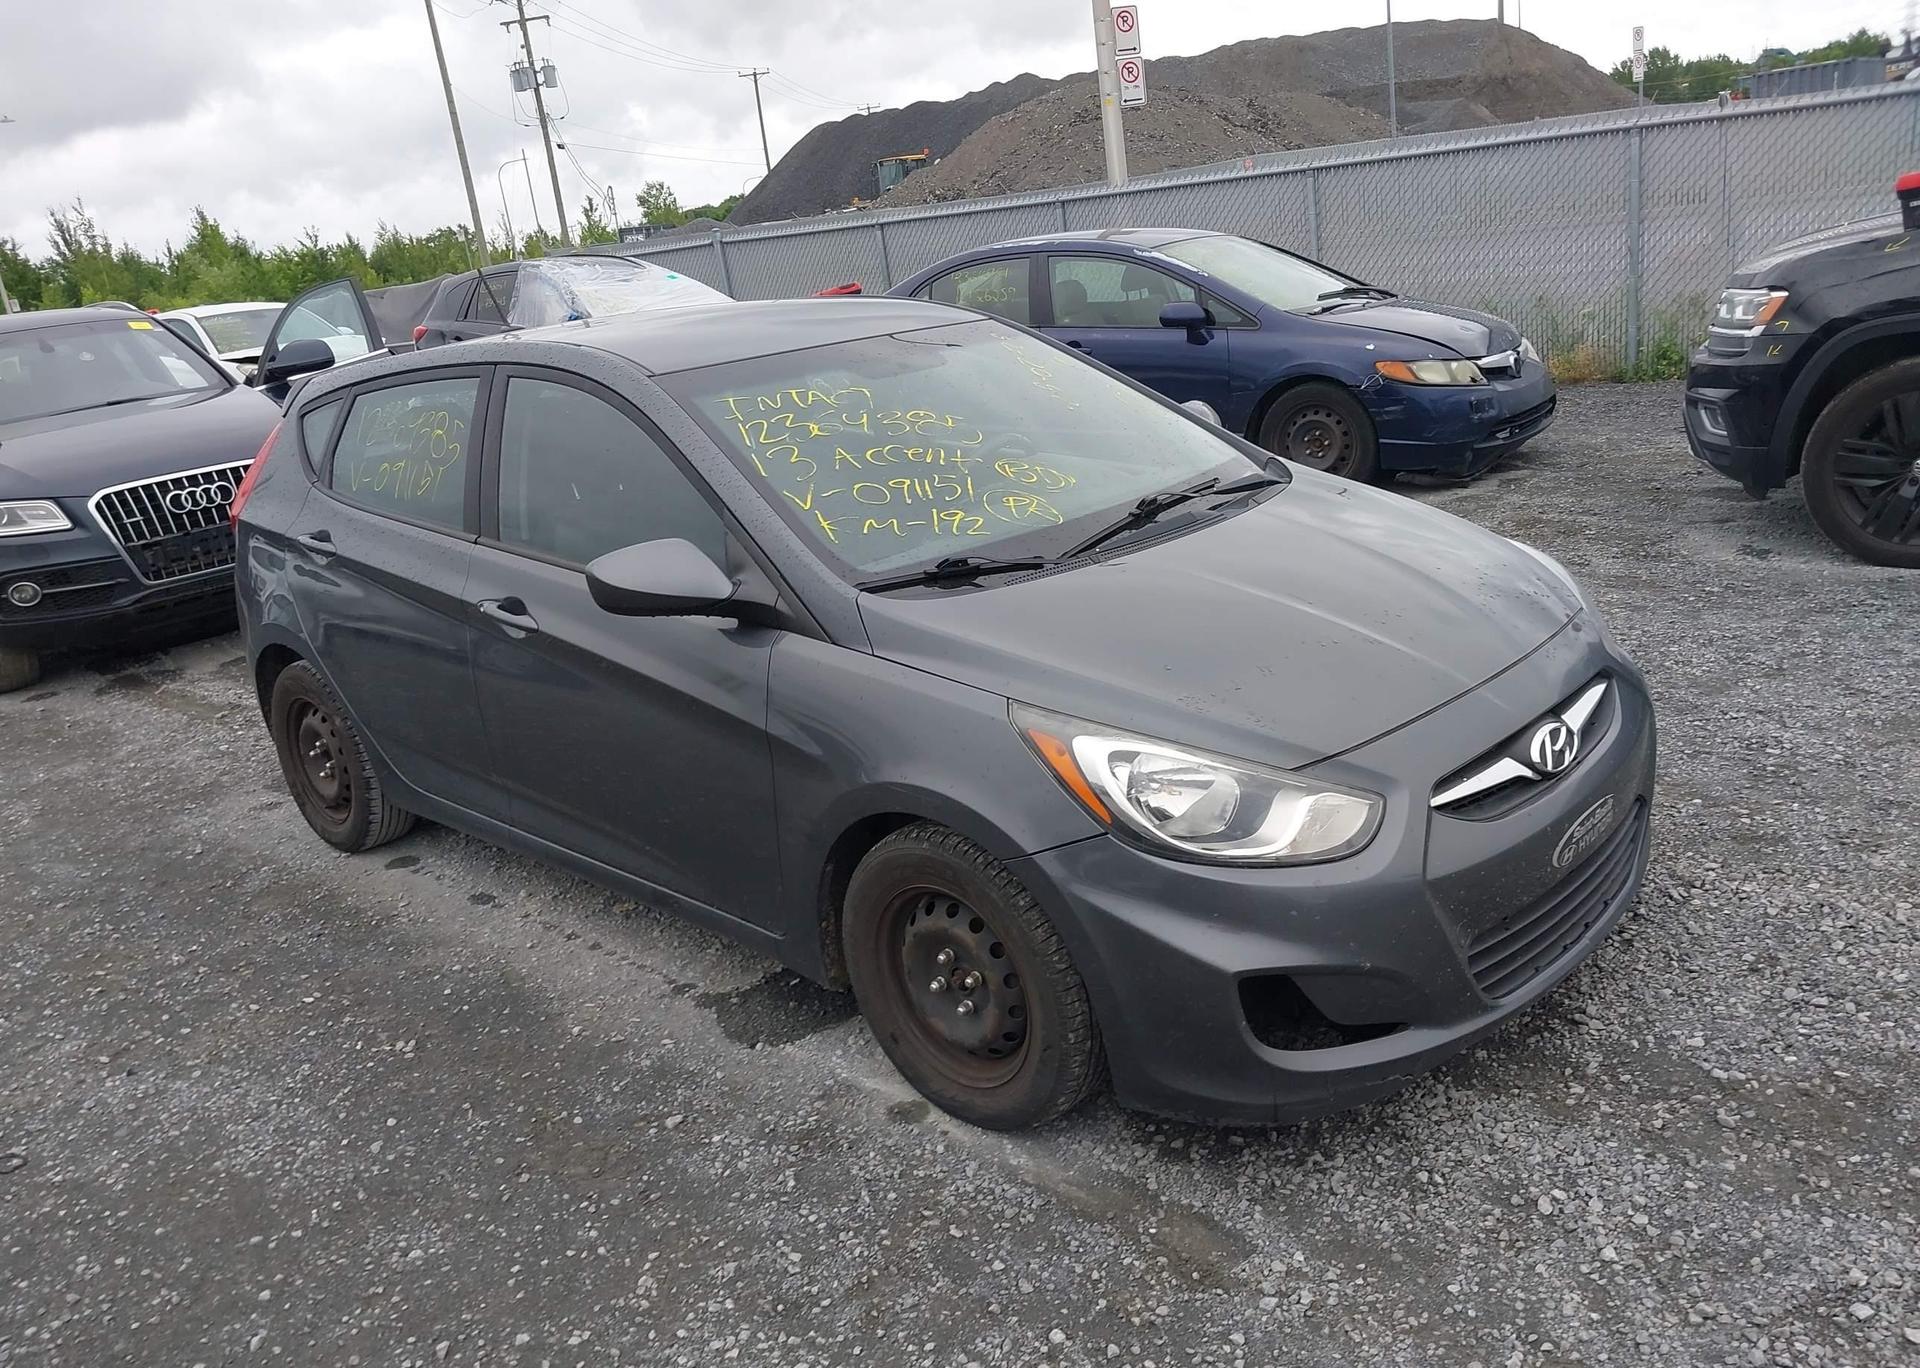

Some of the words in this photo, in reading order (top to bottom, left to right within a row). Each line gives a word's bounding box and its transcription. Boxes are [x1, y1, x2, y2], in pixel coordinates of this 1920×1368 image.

[751, 444, 817, 481] 13
[834, 444, 984, 474] Accent
[783, 472, 976, 511] V-091151
